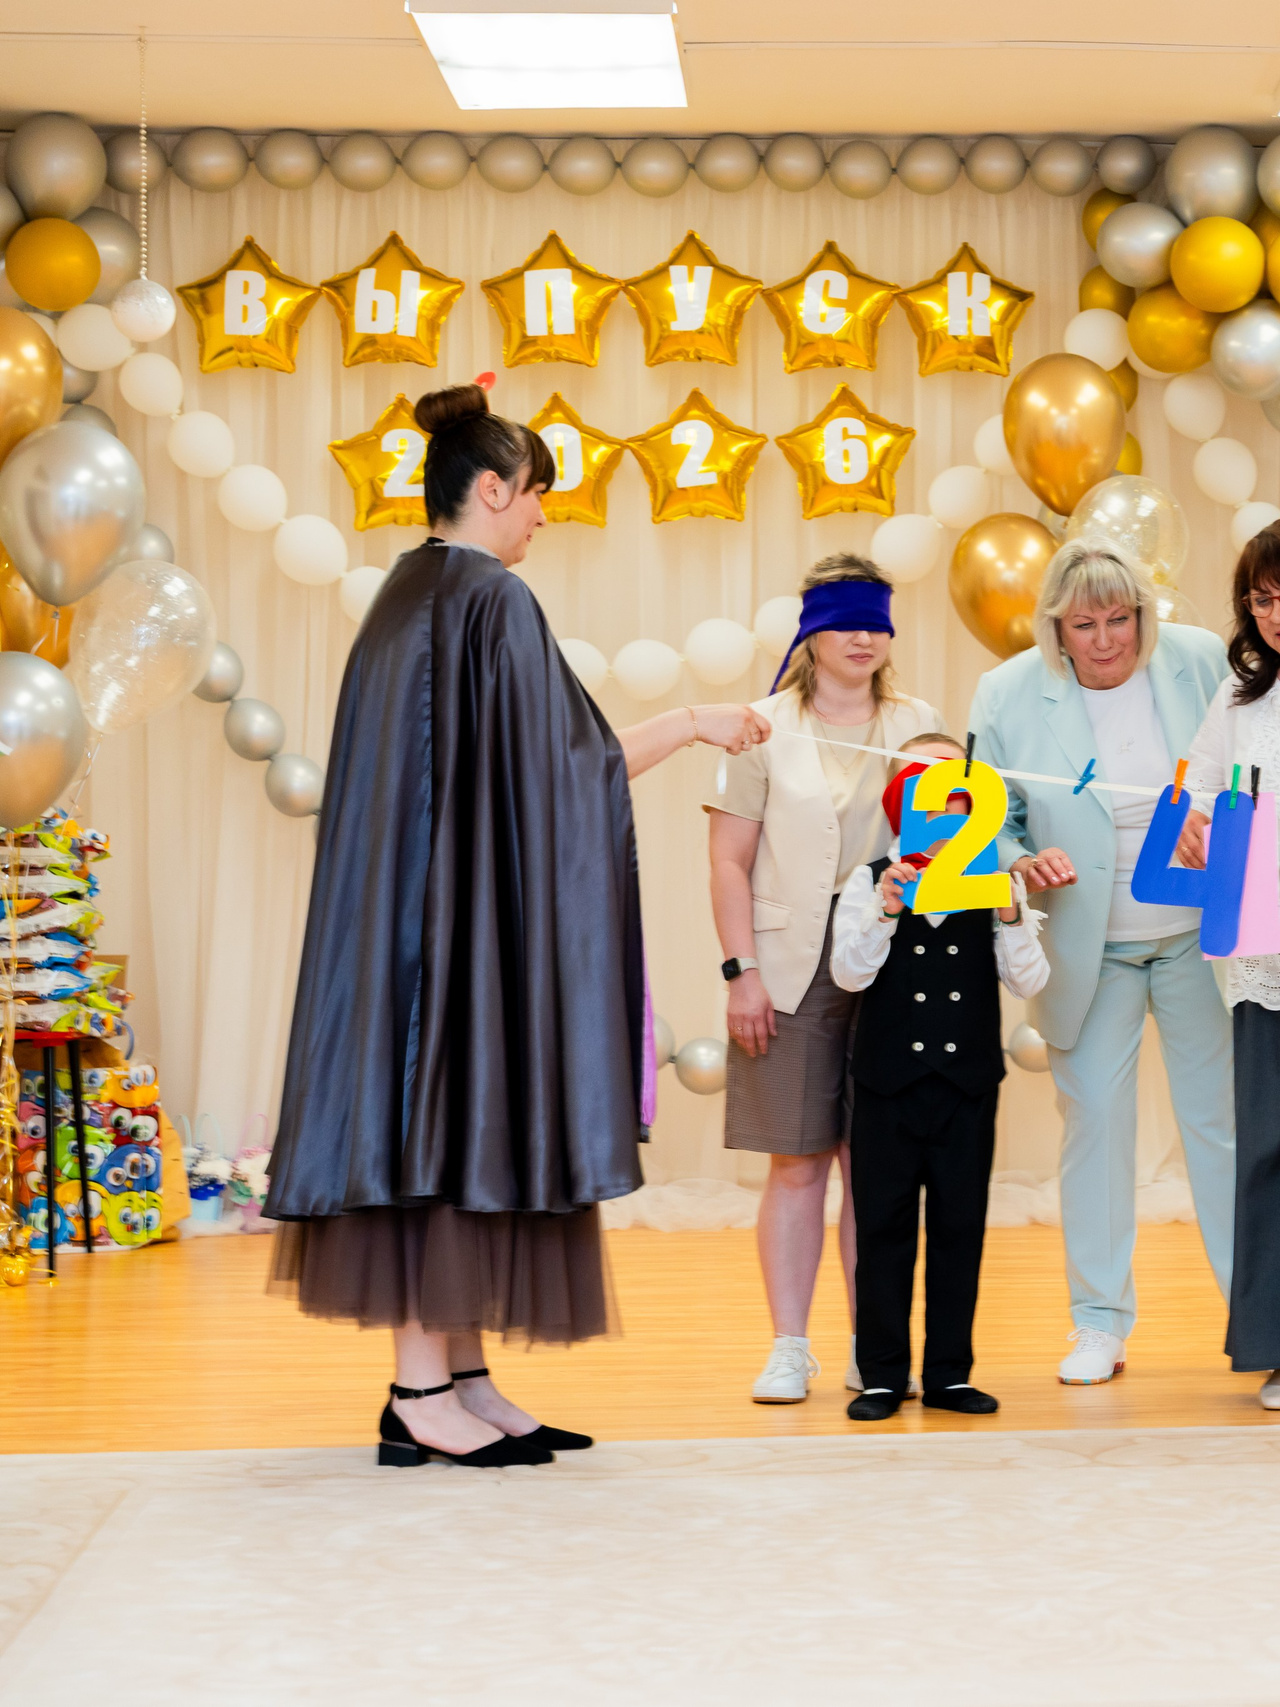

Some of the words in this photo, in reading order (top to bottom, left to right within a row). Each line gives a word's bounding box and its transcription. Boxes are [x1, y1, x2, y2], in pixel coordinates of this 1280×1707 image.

[223, 265, 991, 338] ВЫПУСК
[912, 758, 1013, 916] 2
[1131, 783, 1255, 957] 4
